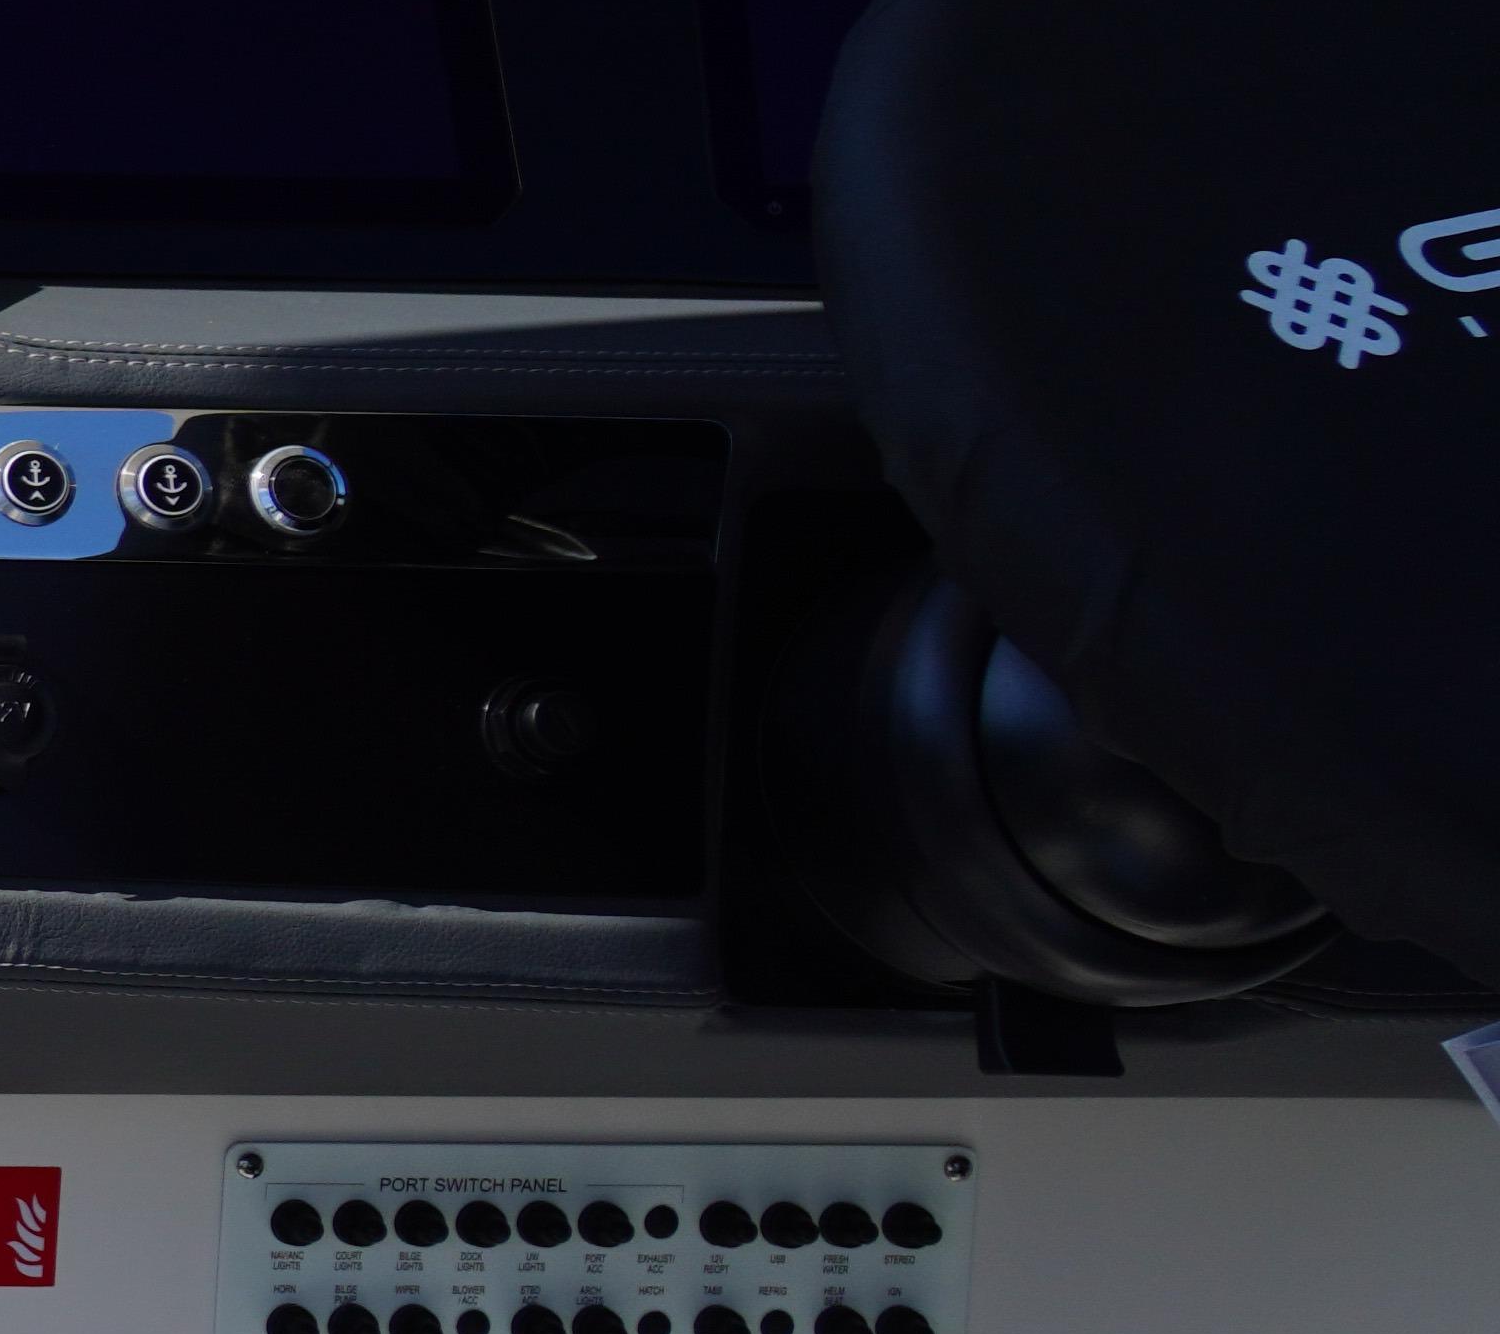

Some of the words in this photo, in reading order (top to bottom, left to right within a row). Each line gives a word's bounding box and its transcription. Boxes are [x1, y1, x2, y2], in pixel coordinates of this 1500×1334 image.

[379, 1177, 429, 1193] PORT
[433, 1177, 505, 1195] SWITCH
[509, 1178, 568, 1195] PANEL
[336, 1251, 363, 1260] COURT
[399, 1252, 422, 1260] BILGE
[460, 1252, 483, 1261] DOCK
[585, 1254, 607, 1263] PORT
[884, 1255, 915, 1264] STEREO
[272, 1262, 300, 1270] LIGHTS
[334, 1262, 362, 1271] LIGHTS
[396, 1262, 423, 1271] LIGHTS
[457, 1263, 485, 1272] LIGHTS
[518, 1263, 545, 1271] LIGHTS
[823, 1266, 849, 1274] WATER
[274, 1285, 296, 1294] HORN
[395, 1285, 420, 1294] WIPER
[452, 1285, 485, 1295] BLOWER
[639, 1286, 664, 1295] HATCH
